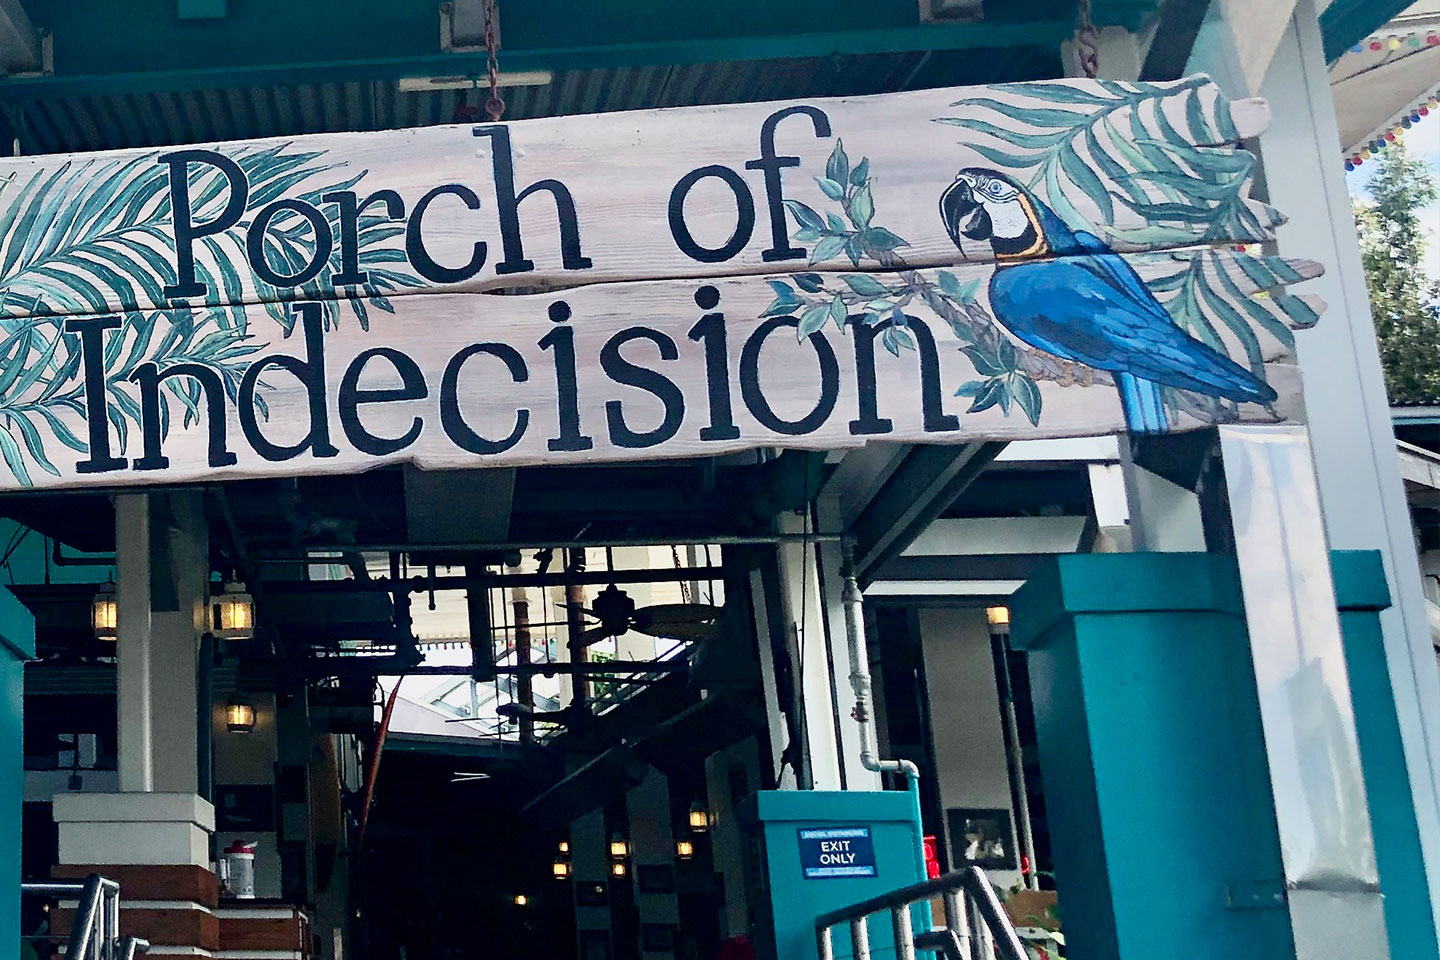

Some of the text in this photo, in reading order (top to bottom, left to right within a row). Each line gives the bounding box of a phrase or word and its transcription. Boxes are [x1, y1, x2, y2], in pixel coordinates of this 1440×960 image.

[160, 105, 831, 299] Porch of
[65, 285, 960, 475] Indecision
[819, 852, 856, 865] ONLY
[820, 840, 851, 852] EXIT
